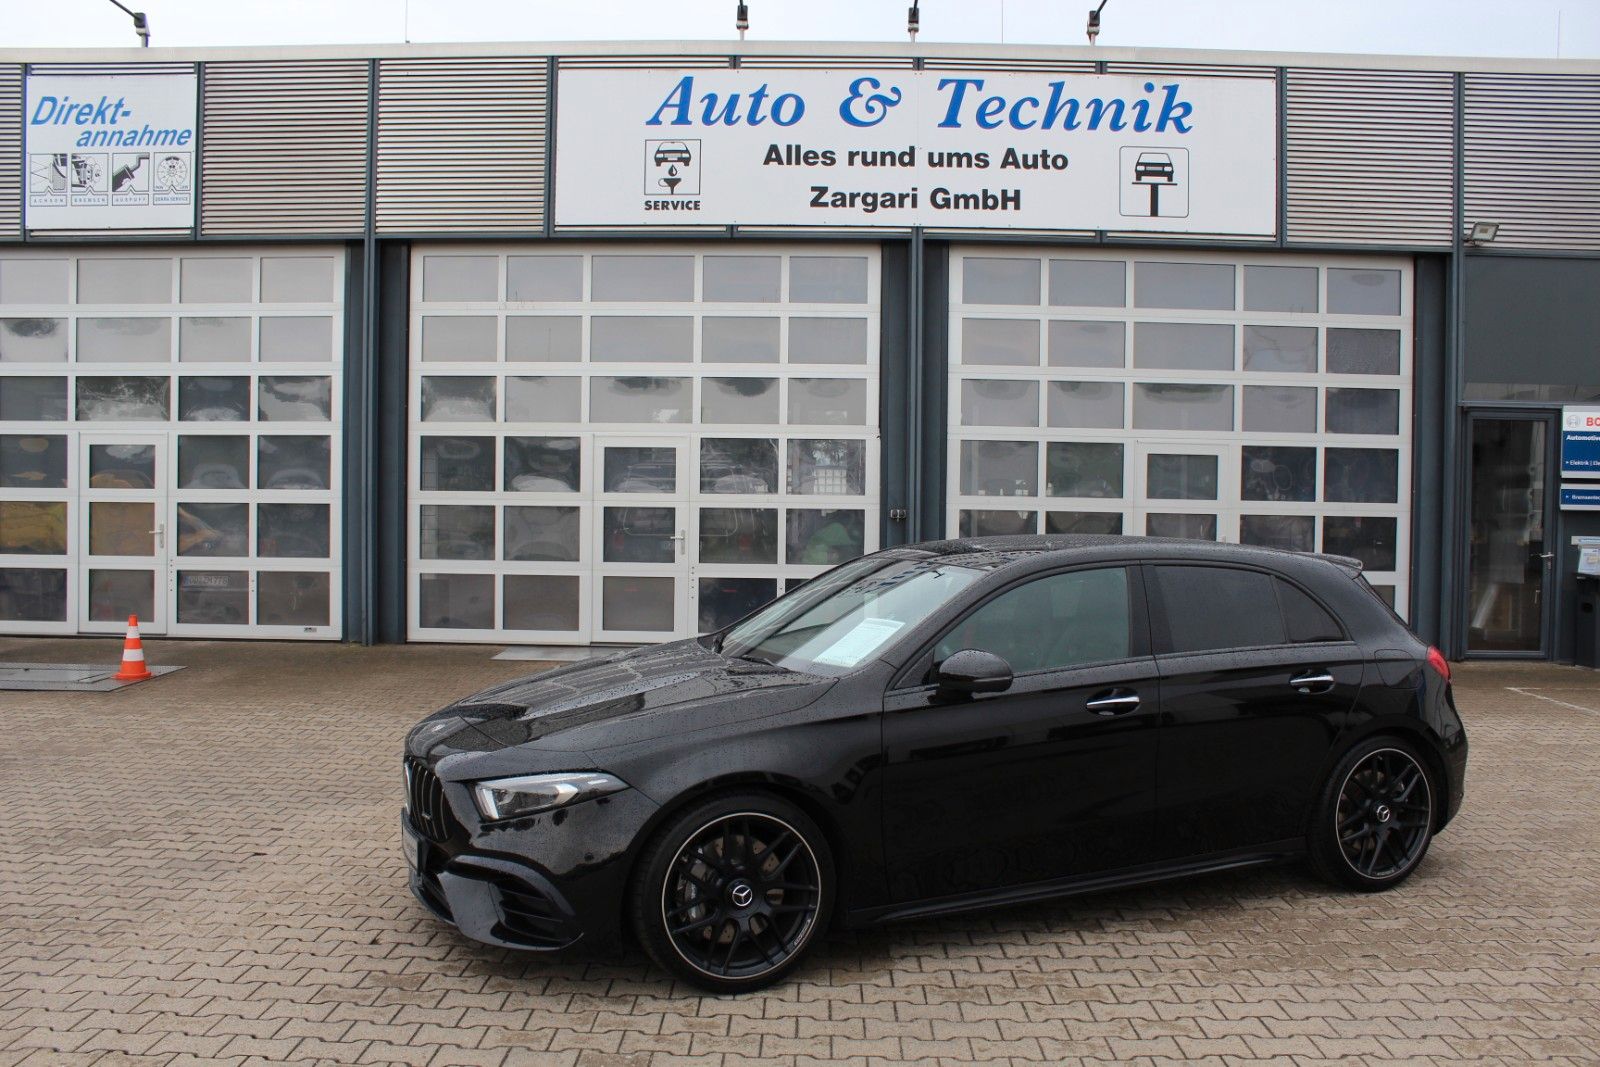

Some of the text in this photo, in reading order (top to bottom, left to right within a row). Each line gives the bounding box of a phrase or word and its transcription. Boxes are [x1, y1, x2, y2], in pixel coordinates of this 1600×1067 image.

[31, 95, 132, 126] Direkt-
[645, 75, 1194, 134] Auto & Technik
[76, 124, 192, 148] annahme
[762, 143, 1069, 171] Alles rund ums Auto
[644, 200, 701, 211] SERVICE
[810, 185, 1021, 214] Zargari GmbH
